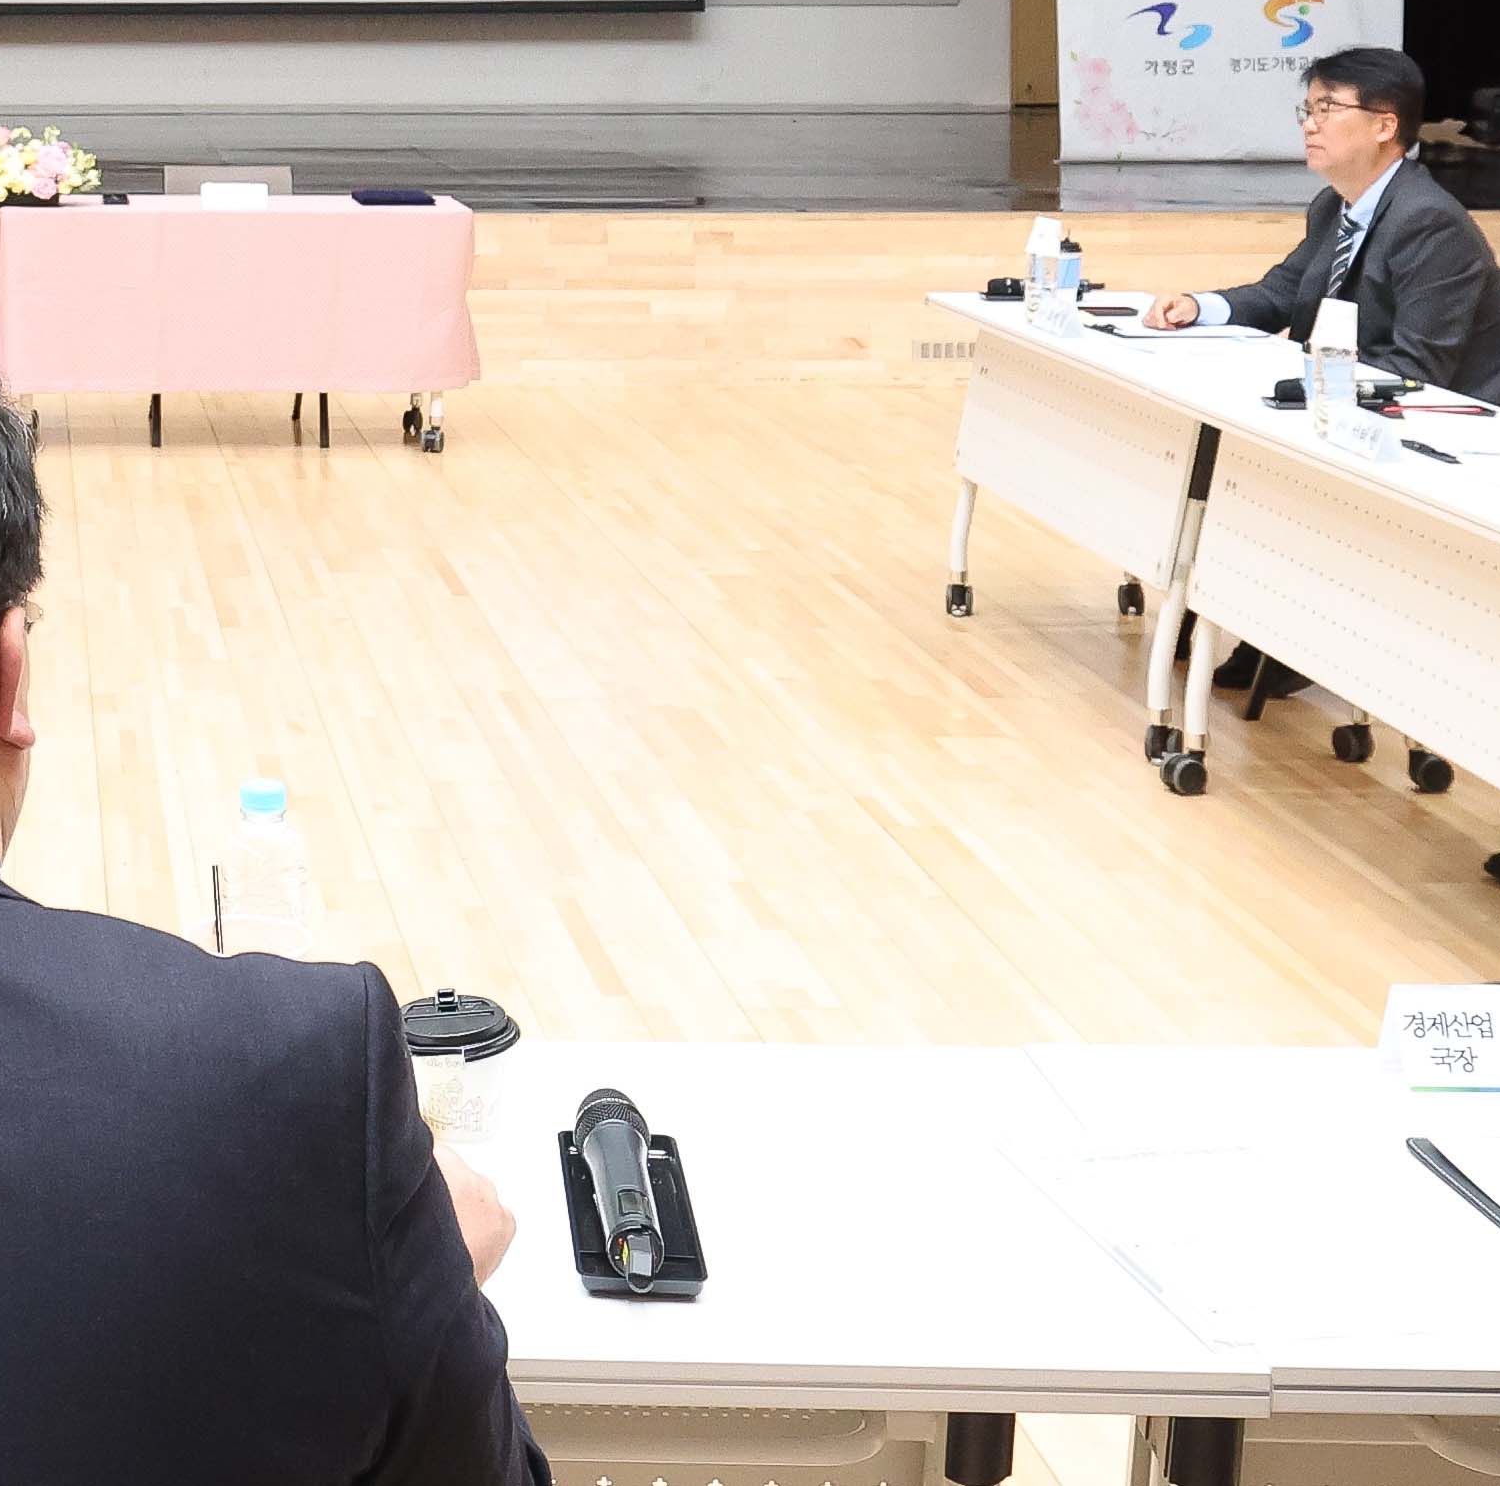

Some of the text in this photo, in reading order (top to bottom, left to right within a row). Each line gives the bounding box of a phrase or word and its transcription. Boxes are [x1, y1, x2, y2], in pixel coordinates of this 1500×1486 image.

[1144, 59, 1195, 76] 가평군
[1404, 1011, 1494, 1039] 경제산업
[1431, 1046, 1478, 1073] 국장
